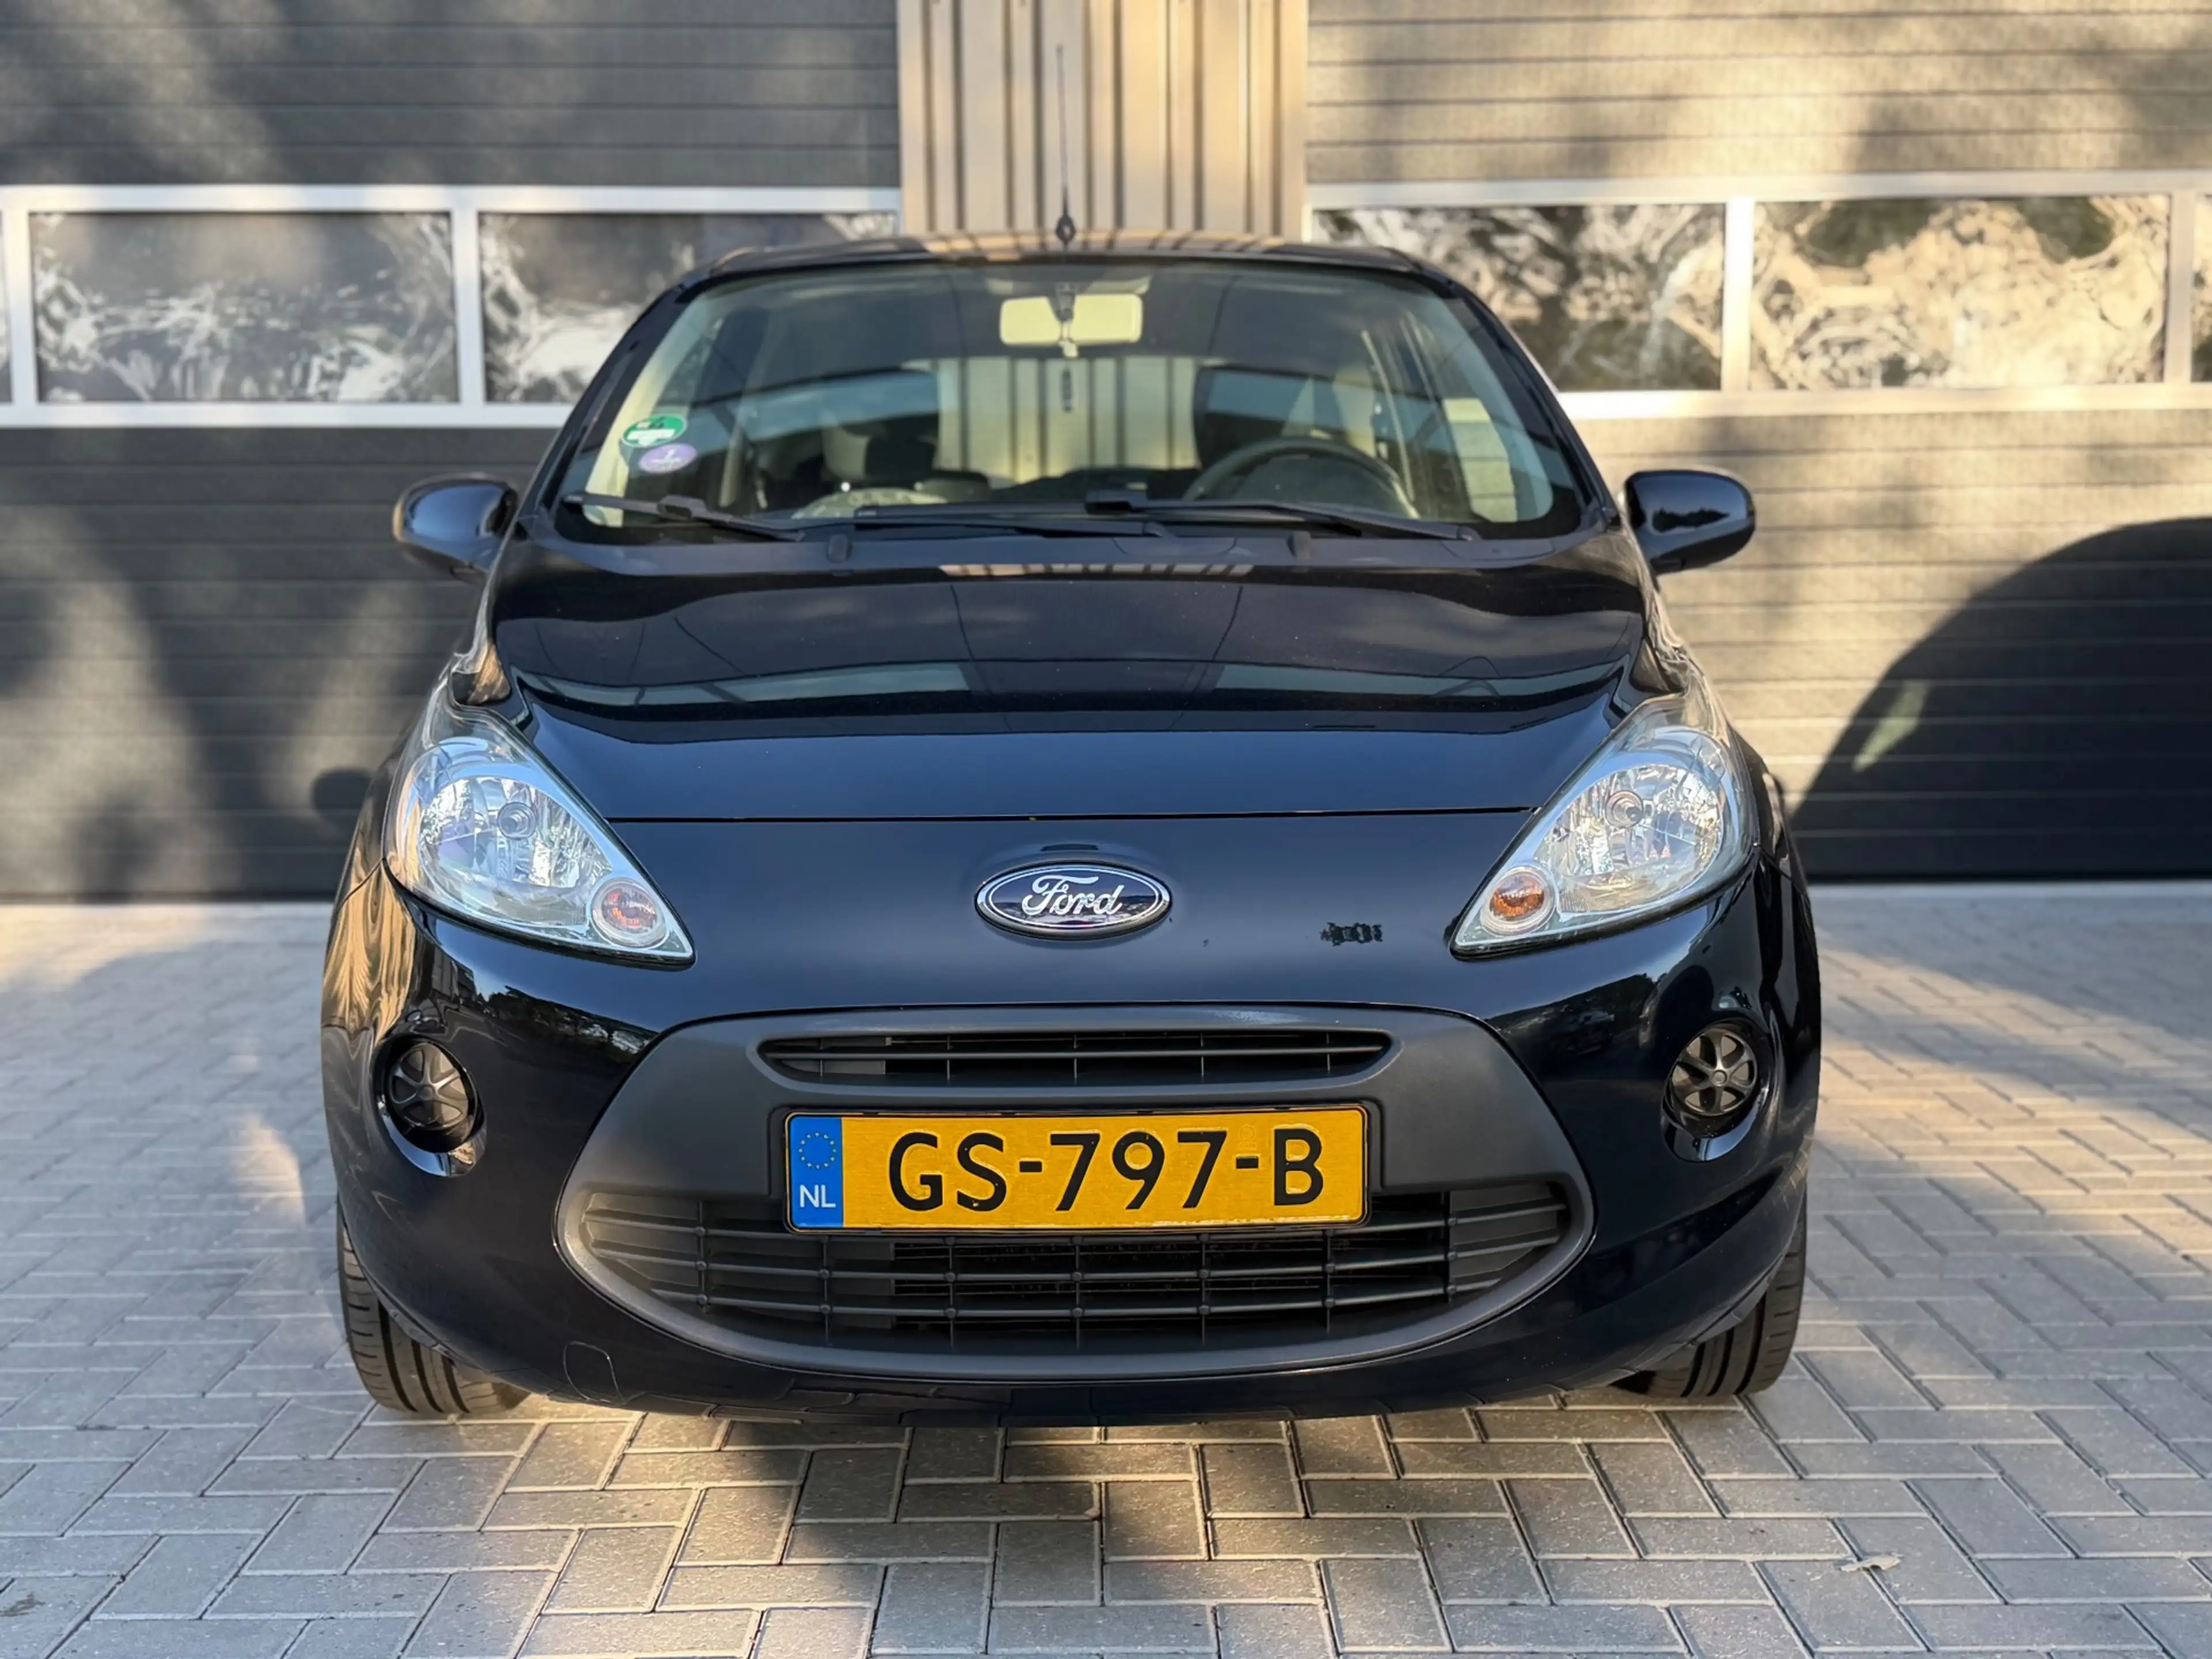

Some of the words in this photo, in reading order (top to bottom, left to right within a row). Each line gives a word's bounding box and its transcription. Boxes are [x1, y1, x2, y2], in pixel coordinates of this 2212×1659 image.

[1021, 874, 1125, 916] Ford
[889, 1128, 1324, 1212] GS-797-B
[800, 1184, 836, 1208] NL
